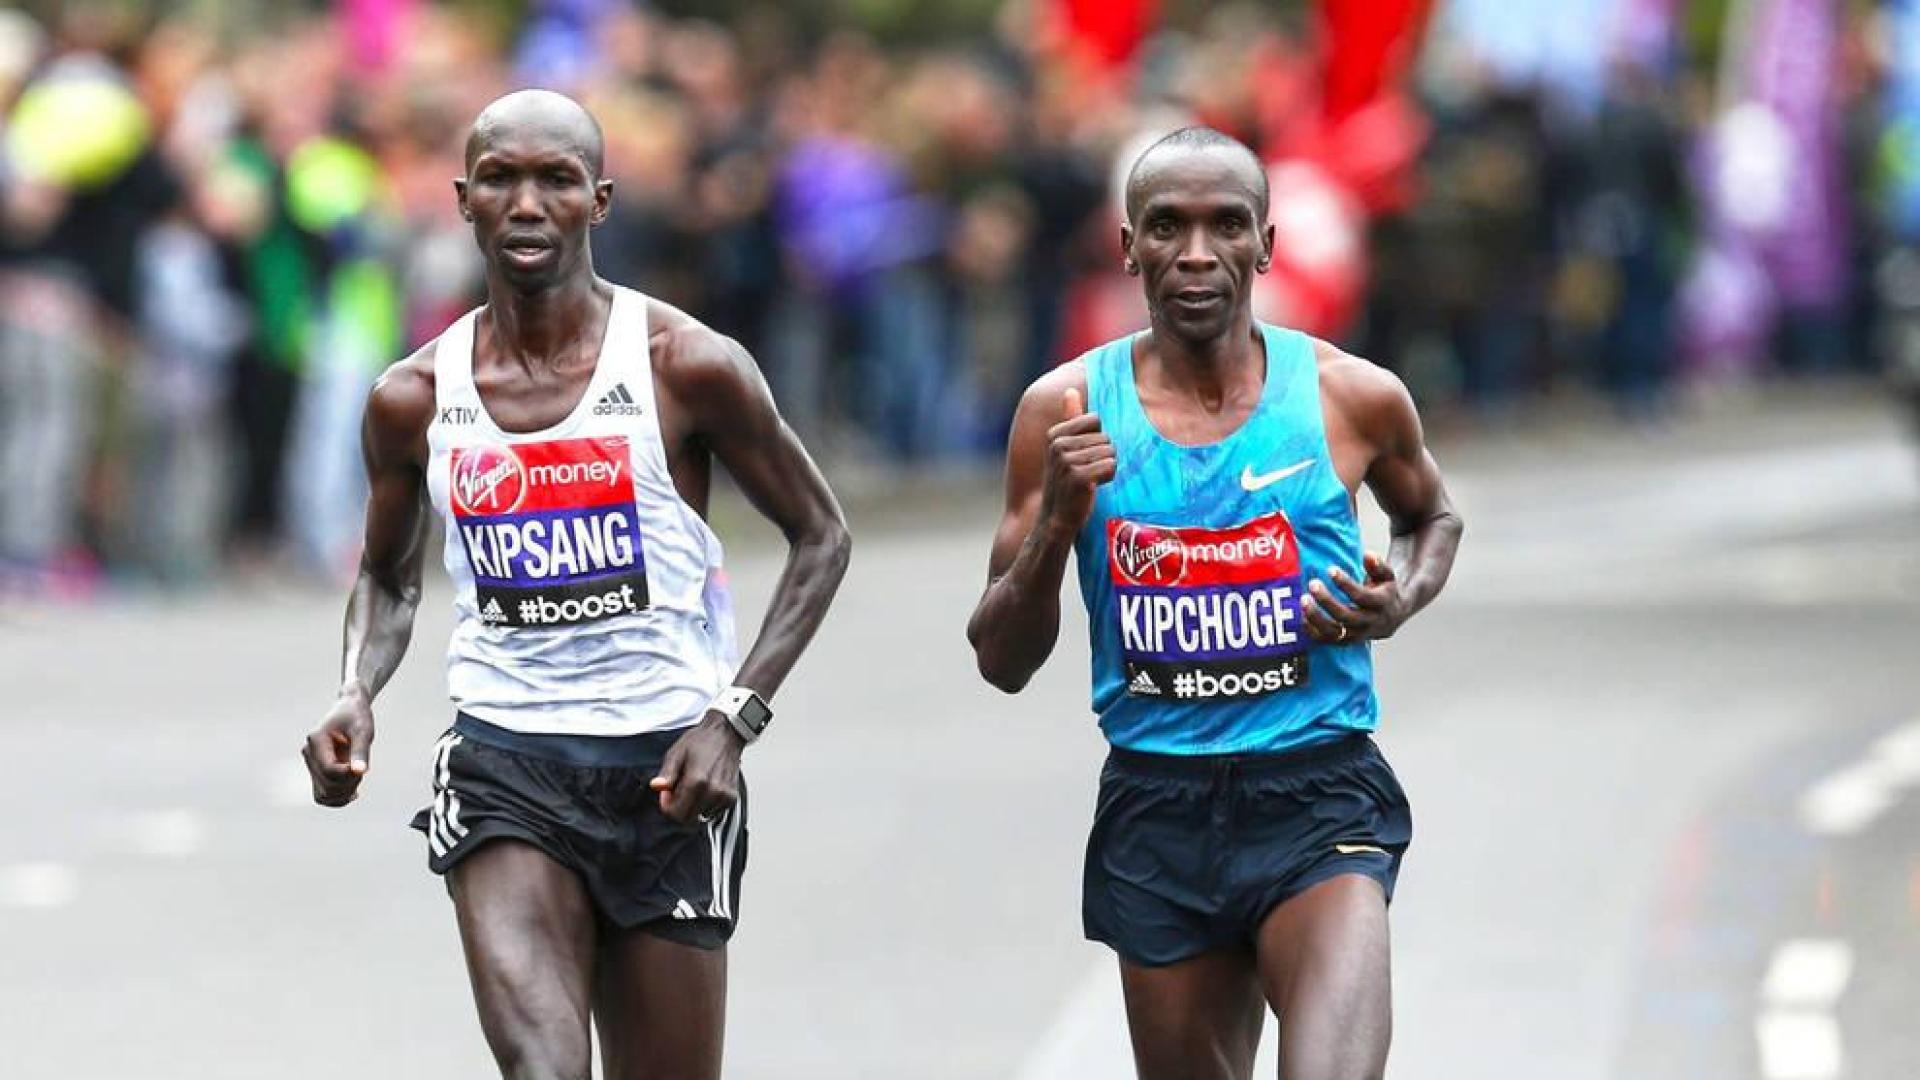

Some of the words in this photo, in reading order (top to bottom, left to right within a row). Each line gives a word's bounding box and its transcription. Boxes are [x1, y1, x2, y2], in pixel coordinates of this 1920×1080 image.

[592, 404, 643, 416] adidas
[459, 446, 518, 508] Virgin
[529, 460, 622, 487] money
[463, 512, 634, 579] KIPSANG
[1120, 523, 1183, 581] Virgin
[1191, 531, 1286, 562] money
[519, 583, 636, 624] #boost
[1120, 587, 1297, 653] KIPCHOGE
[1173, 662, 1296, 698] #boost
